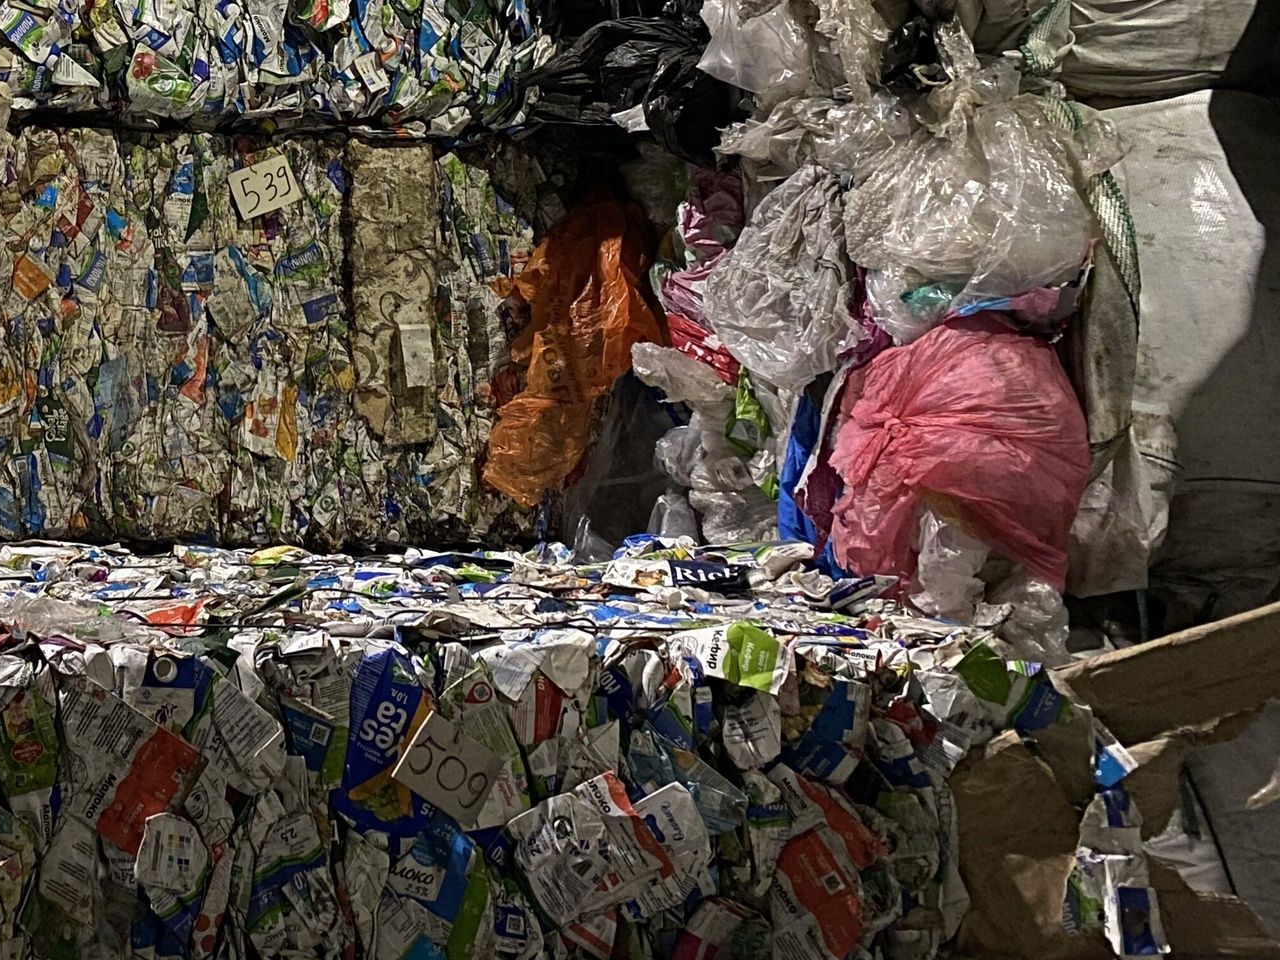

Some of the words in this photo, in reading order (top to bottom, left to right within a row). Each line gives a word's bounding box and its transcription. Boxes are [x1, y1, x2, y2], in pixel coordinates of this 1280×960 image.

[8, 13, 35, 45] МОЛОКО
[249, 13, 272, 44] Молоко
[241, 164, 292, 214] 539
[706, 627, 723, 669] Кефир
[742, 640, 754, 672] Кефир
[407, 736, 489, 809] 509
[82, 770, 118, 821] Молоко
[778, 775, 810, 811] Молоко
